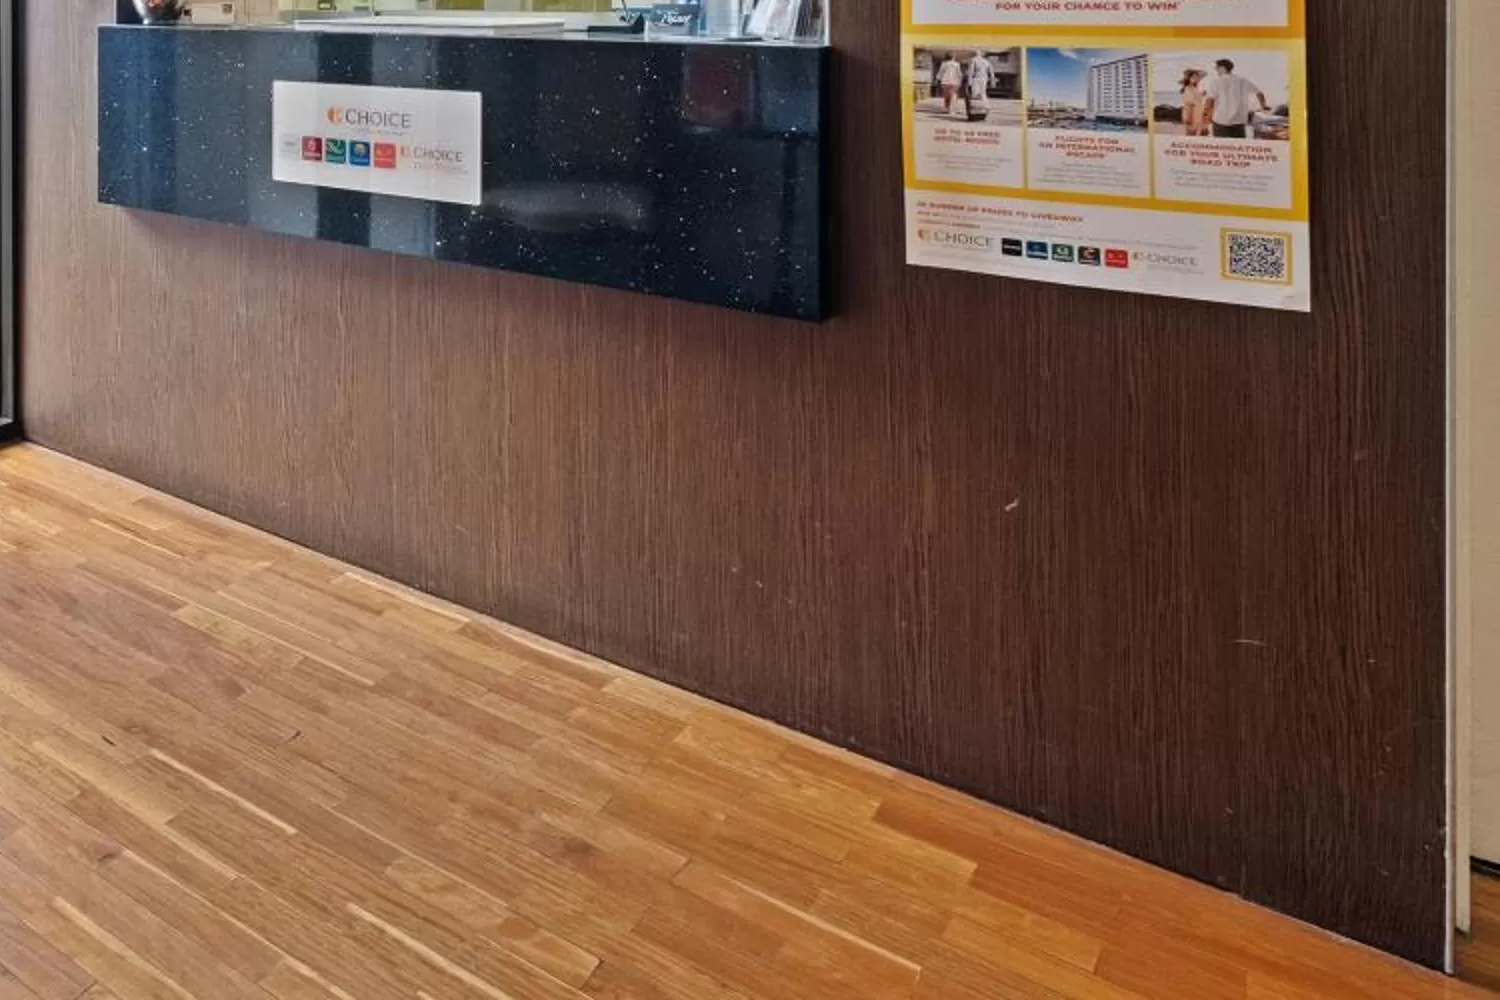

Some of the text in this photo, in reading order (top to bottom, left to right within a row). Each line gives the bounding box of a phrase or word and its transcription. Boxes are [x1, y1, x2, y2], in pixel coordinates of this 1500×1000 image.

[996, 3, 1021, 12] FOR
[1025, 3, 1060, 12] YOUR
[1064, 3, 1120, 12] CHANCE
[1125, 2, 1143, 11] TO
[345, 108, 412, 128] CHOICE
[413, 146, 463, 163] CHOICE
[933, 231, 995, 248] CHOICE
